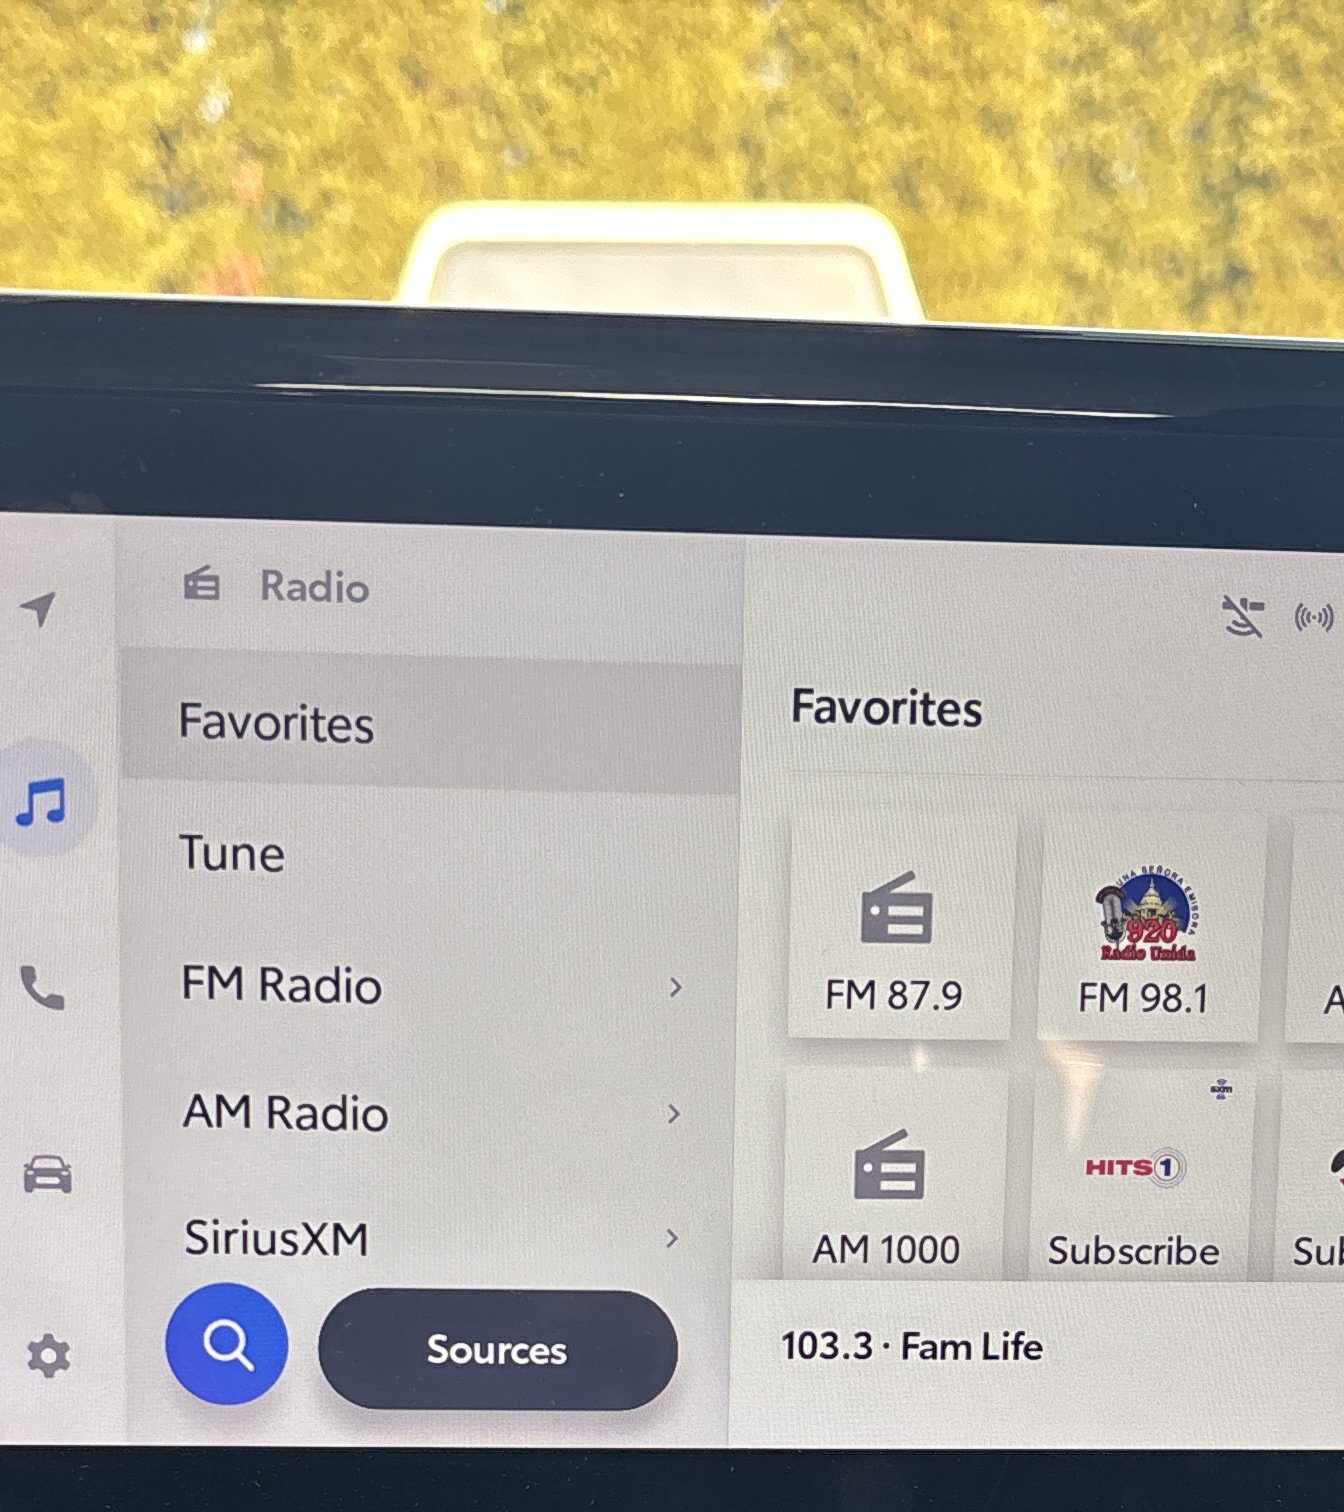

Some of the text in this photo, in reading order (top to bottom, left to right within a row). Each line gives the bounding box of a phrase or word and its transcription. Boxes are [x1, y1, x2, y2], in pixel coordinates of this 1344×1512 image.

[261, 568, 370, 604] Radio
[180, 701, 374, 745] Favorites
[792, 687, 983, 728] Favorites
[179, 833, 285, 873] Tune
[1125, 918, 1178, 944] 920
[1100, 944, 1196, 962] Radio Unida
[183, 964, 382, 1005] FM Radio
[826, 978, 963, 1011] FM 87.9
[1079, 981, 1207, 1014] FM 98.1
[182, 1093, 389, 1133] AM Radio
[185, 1218, 367, 1257] SiriusXM
[812, 1234, 960, 1265] AM 1000
[1048, 1234, 1220, 1267] Subscribe
[427, 1333, 568, 1365] Sources
[782, 1330, 873, 1361] 103.3
[902, 1331, 972, 1361] Fam
[982, 1330, 1044, 1361] Life
